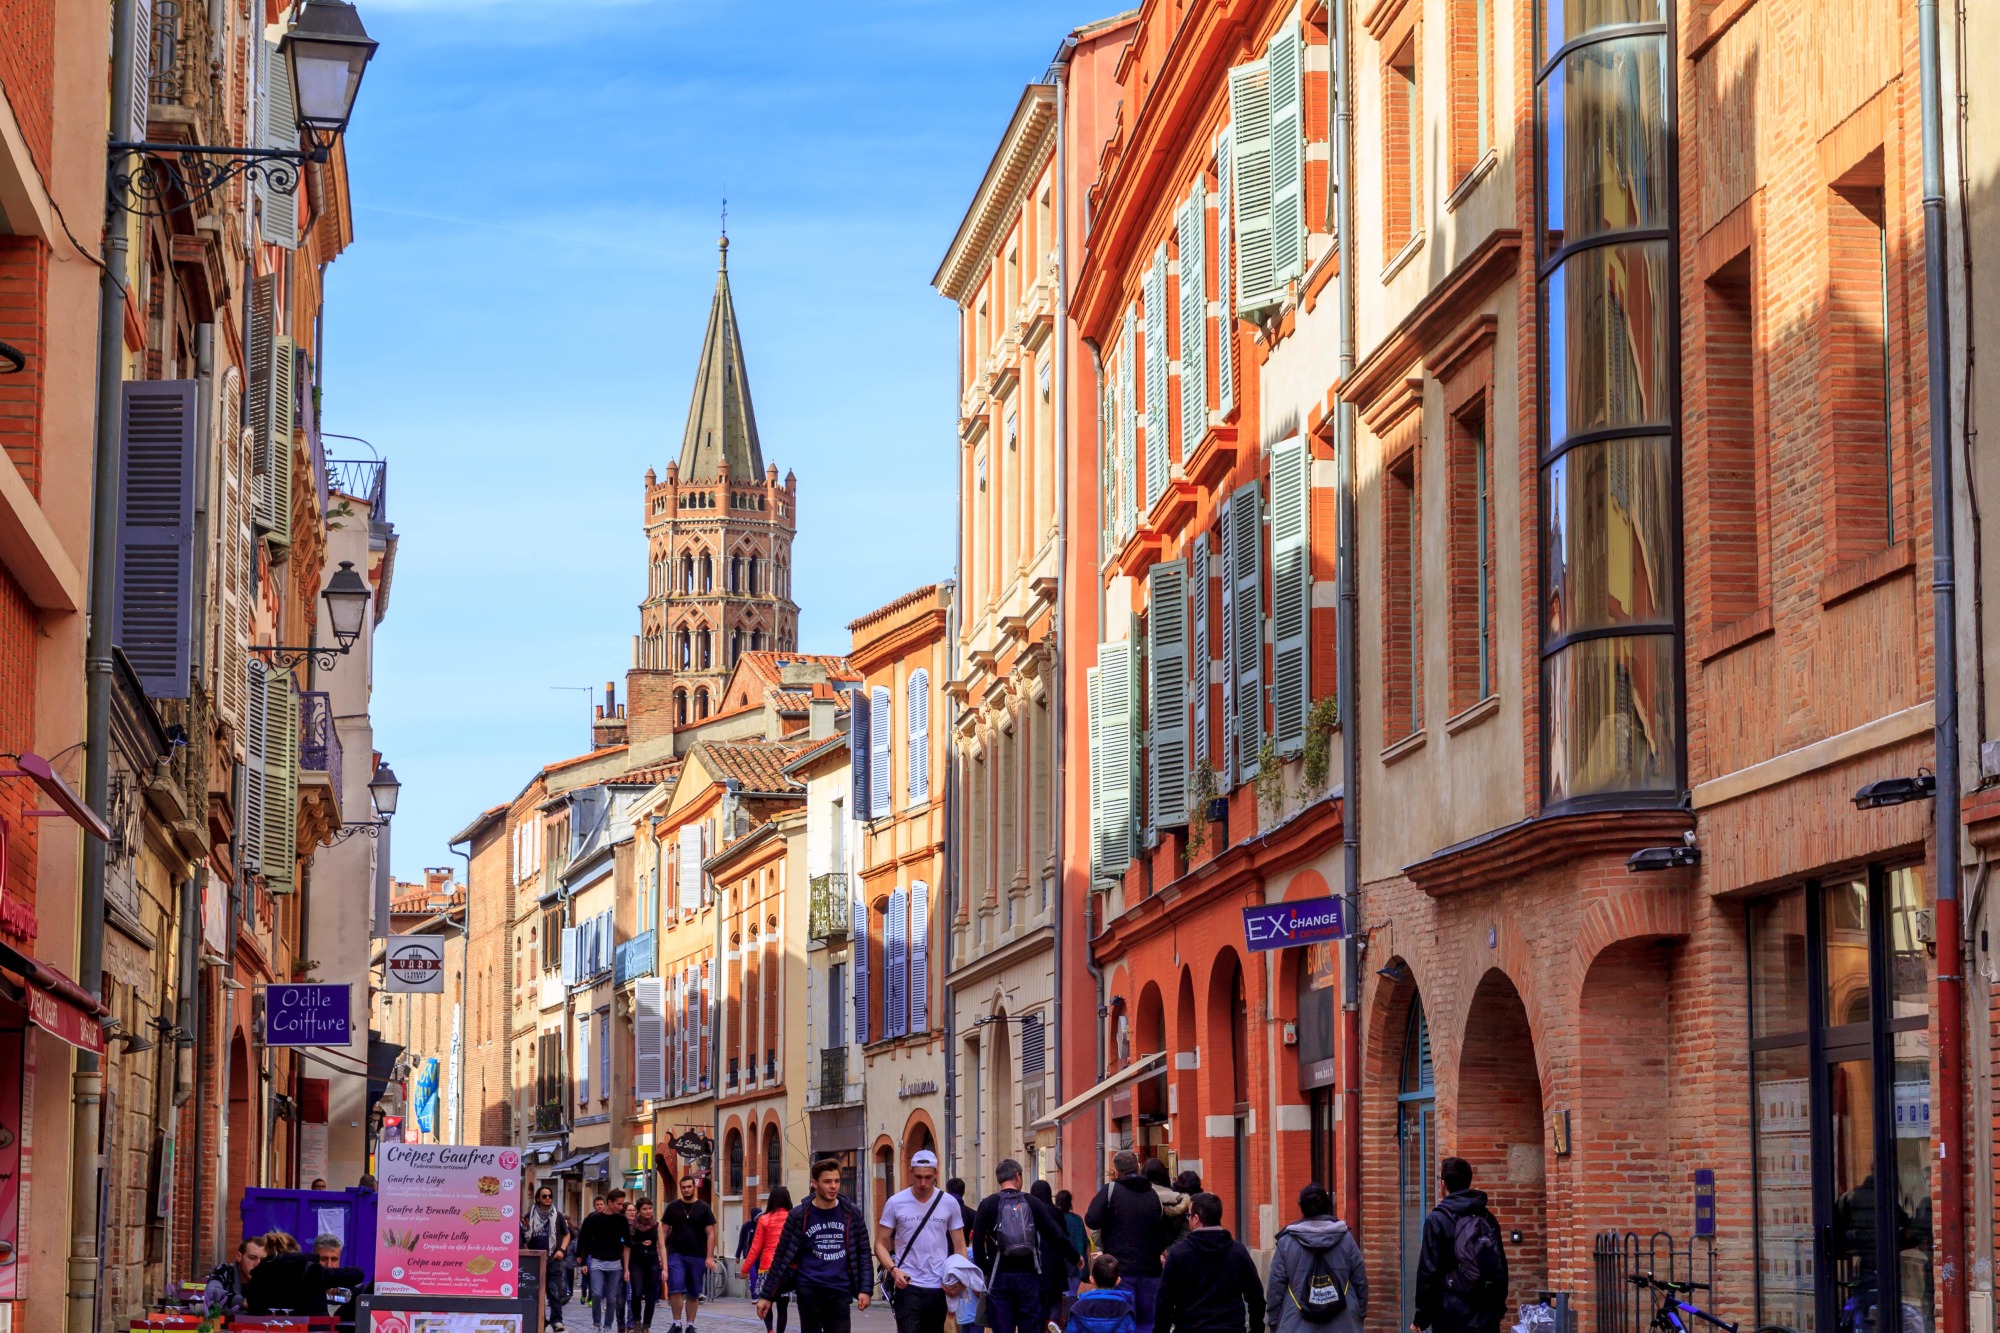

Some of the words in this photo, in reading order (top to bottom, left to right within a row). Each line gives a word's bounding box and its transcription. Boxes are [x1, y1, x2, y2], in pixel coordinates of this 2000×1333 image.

[1247, 914, 1289, 941] EX
[1290, 913, 1337, 929] CHANGE
[1300, 926, 1340, 938] DEVISES
[400, 960, 432, 969] VARD
[282, 988, 332, 1006] Odile
[273, 1008, 346, 1039] Coiffure
[675, 1139, 683, 1147] Le
[440, 1148, 495, 1167] Gaufres
[388, 1175, 414, 1184] Gaufre
[416, 1175, 424, 1183] de
[426, 1176, 445, 1187] Liège
[386, 1205, 413, 1215] Gaufre
[415, 1205, 423, 1214] de
[426, 1206, 461, 1216] Bruxelles
[805, 1223, 821, 1237] ZADIG
[422, 1231, 449, 1241] Gaufre
[451, 1232, 469, 1242] Lolly
